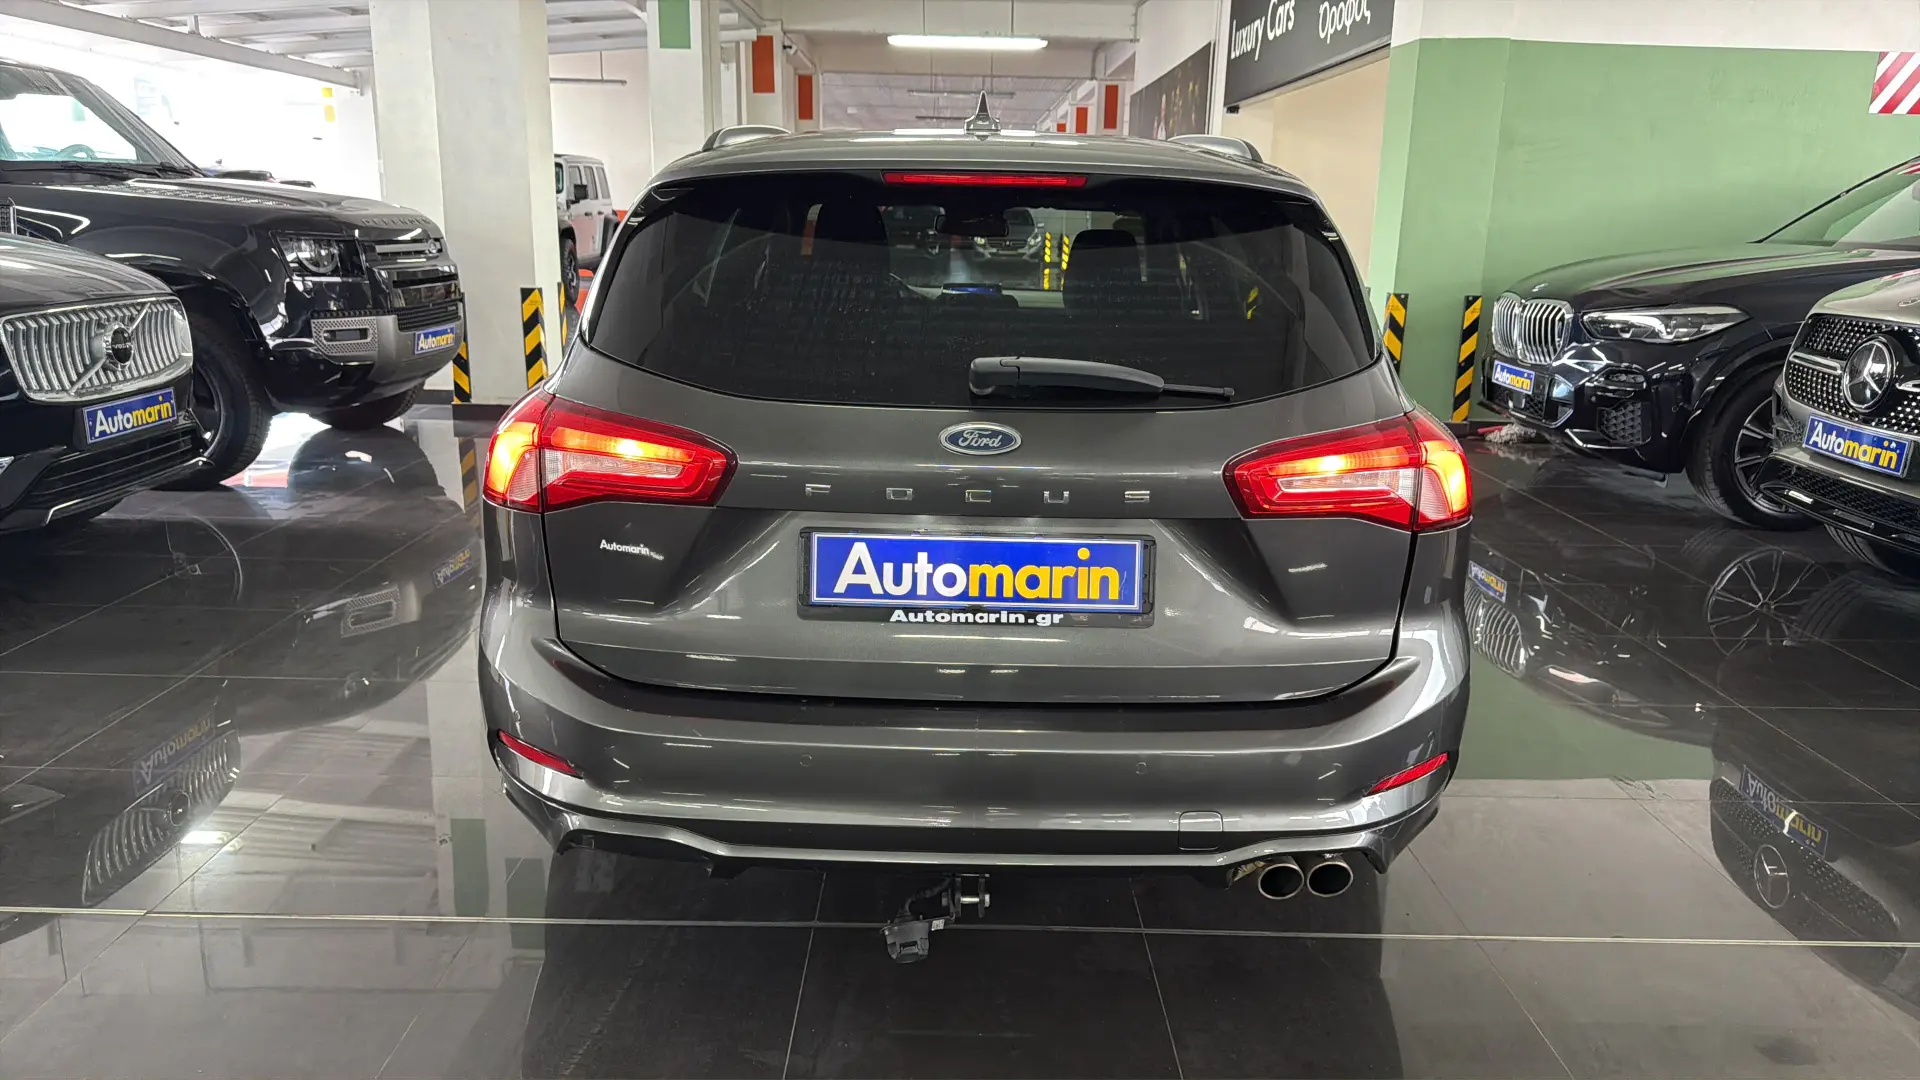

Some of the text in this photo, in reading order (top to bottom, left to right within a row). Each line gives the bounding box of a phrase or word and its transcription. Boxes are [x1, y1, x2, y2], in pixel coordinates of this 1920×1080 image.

[1230, 0, 1295, 61] Luxury Cars
[418, 329, 455, 352] Automarin
[94, 395, 173, 437] Automarin
[958, 429, 1003, 448] Ford
[1808, 421, 1898, 470] Automarin
[805, 483, 1150, 503] FOCUS
[600, 539, 650, 557] Automarin
[832, 541, 1120, 601] Automarin
[889, 609, 1064, 627] Automarin.gr
